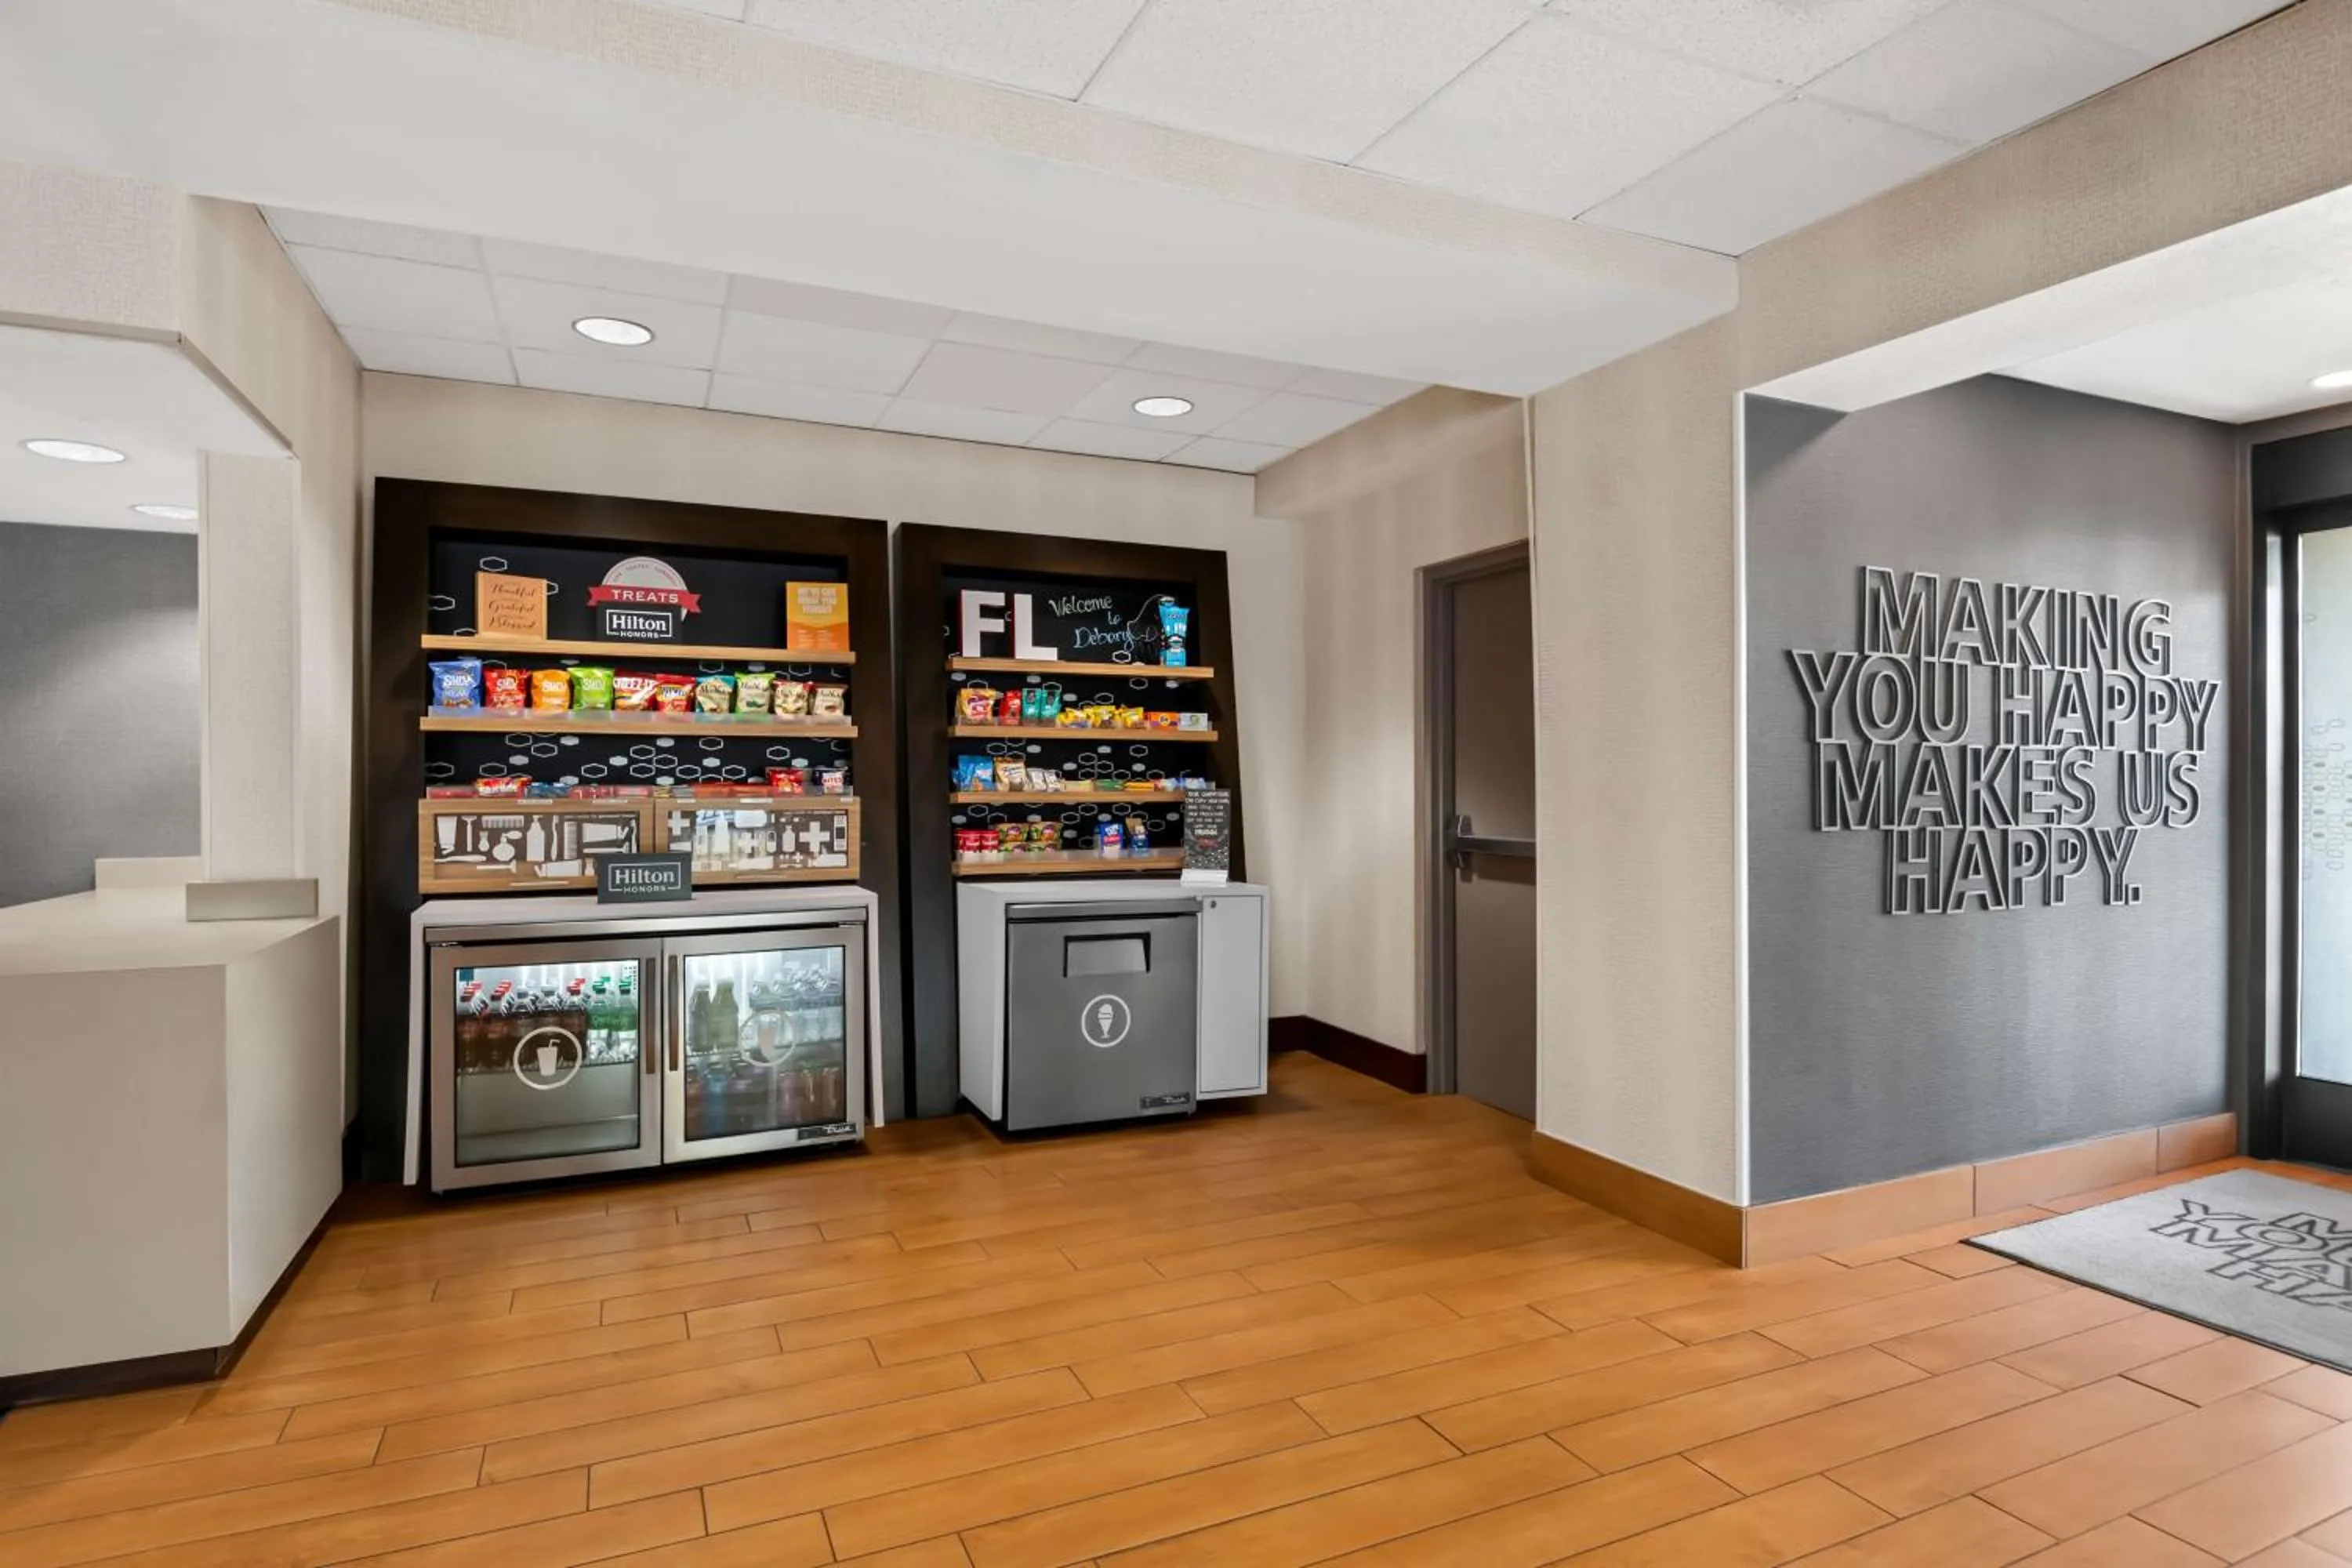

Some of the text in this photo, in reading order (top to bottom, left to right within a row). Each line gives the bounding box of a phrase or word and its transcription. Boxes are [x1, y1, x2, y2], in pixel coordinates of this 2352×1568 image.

[611, 589, 679, 604] TREATS
[1048, 595, 1113, 617] Welcome
[612, 614, 667, 631] Hilton
[961, 589, 1058, 662] FL
[1107, 611, 1121, 626] to
[1861, 564, 2172, 679] MAKING
[1788, 648, 2222, 753] YOU HAPPY
[1817, 739, 2201, 832] MAKES US
[615, 869, 676, 885] Hilton
[1886, 826, 2143, 915] HAPPY.
[623, 884, 666, 893] HONORS
